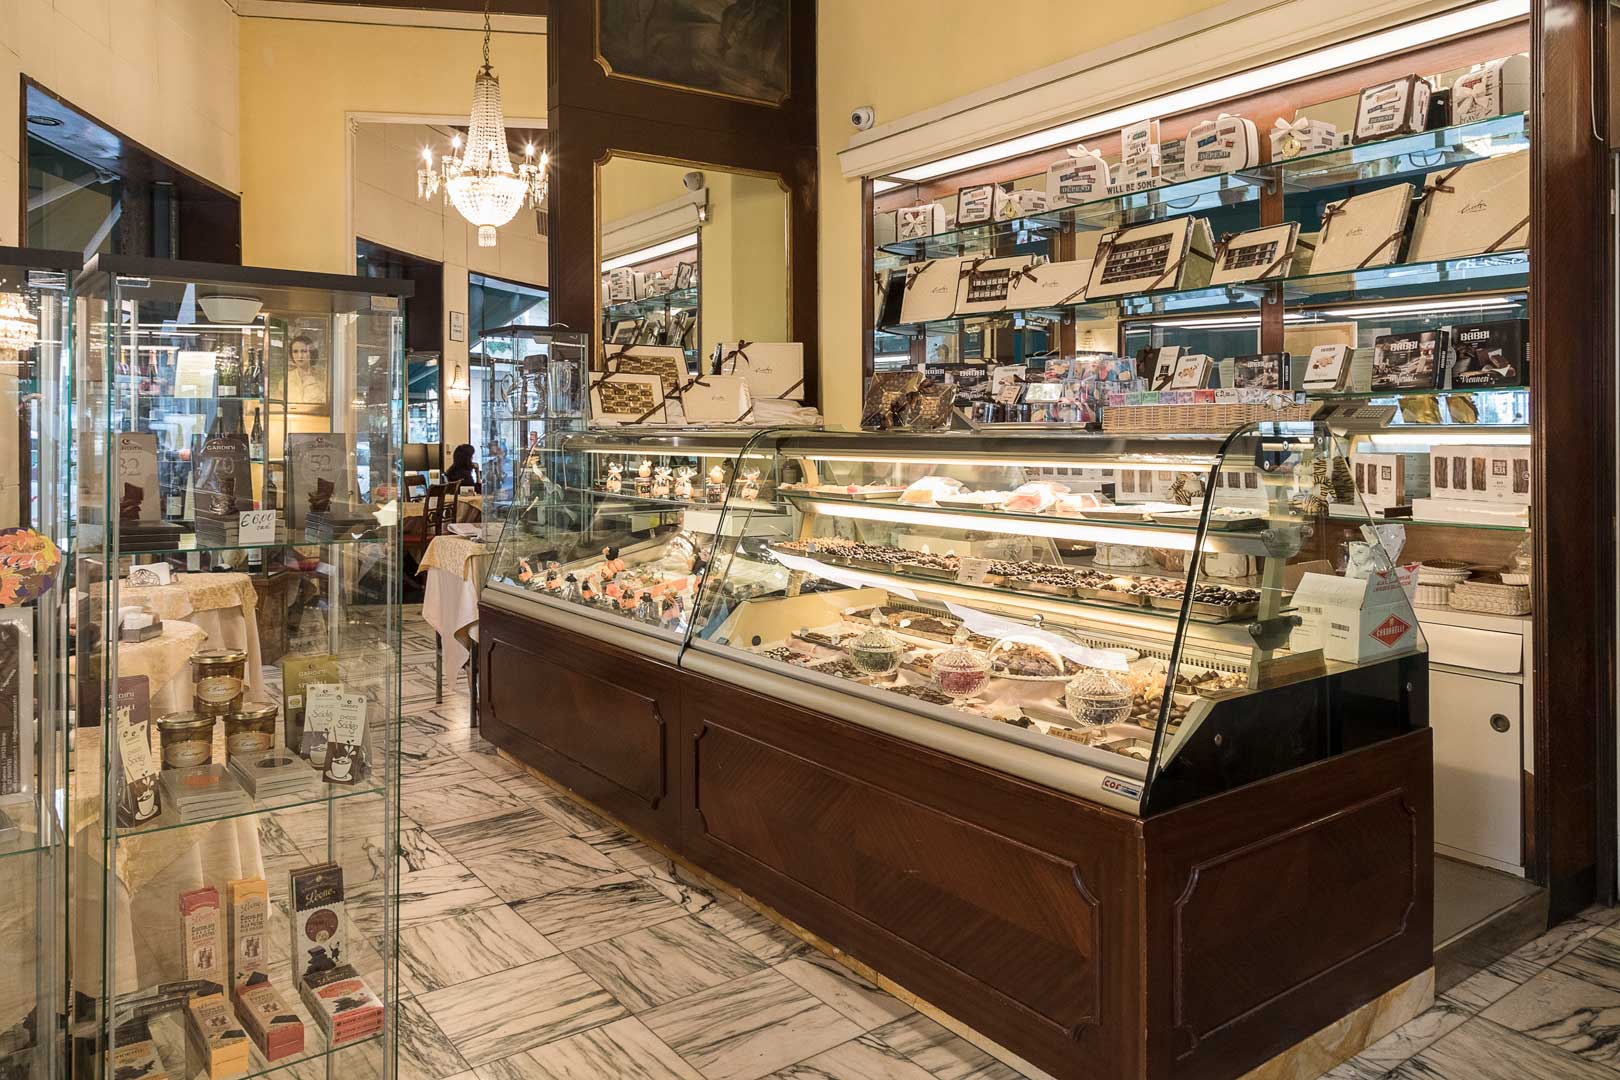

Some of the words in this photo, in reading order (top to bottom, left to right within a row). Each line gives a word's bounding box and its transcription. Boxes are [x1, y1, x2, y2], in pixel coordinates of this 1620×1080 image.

[1106, 183, 1123, 195] WILL
[1126, 182, 1135, 192] BE
[1137, 180, 1157, 190] SOME
[1460, 330, 1490, 341] BABBI
[1390, 340, 1418, 352] BABBI
[310, 455, 333, 472] 52
